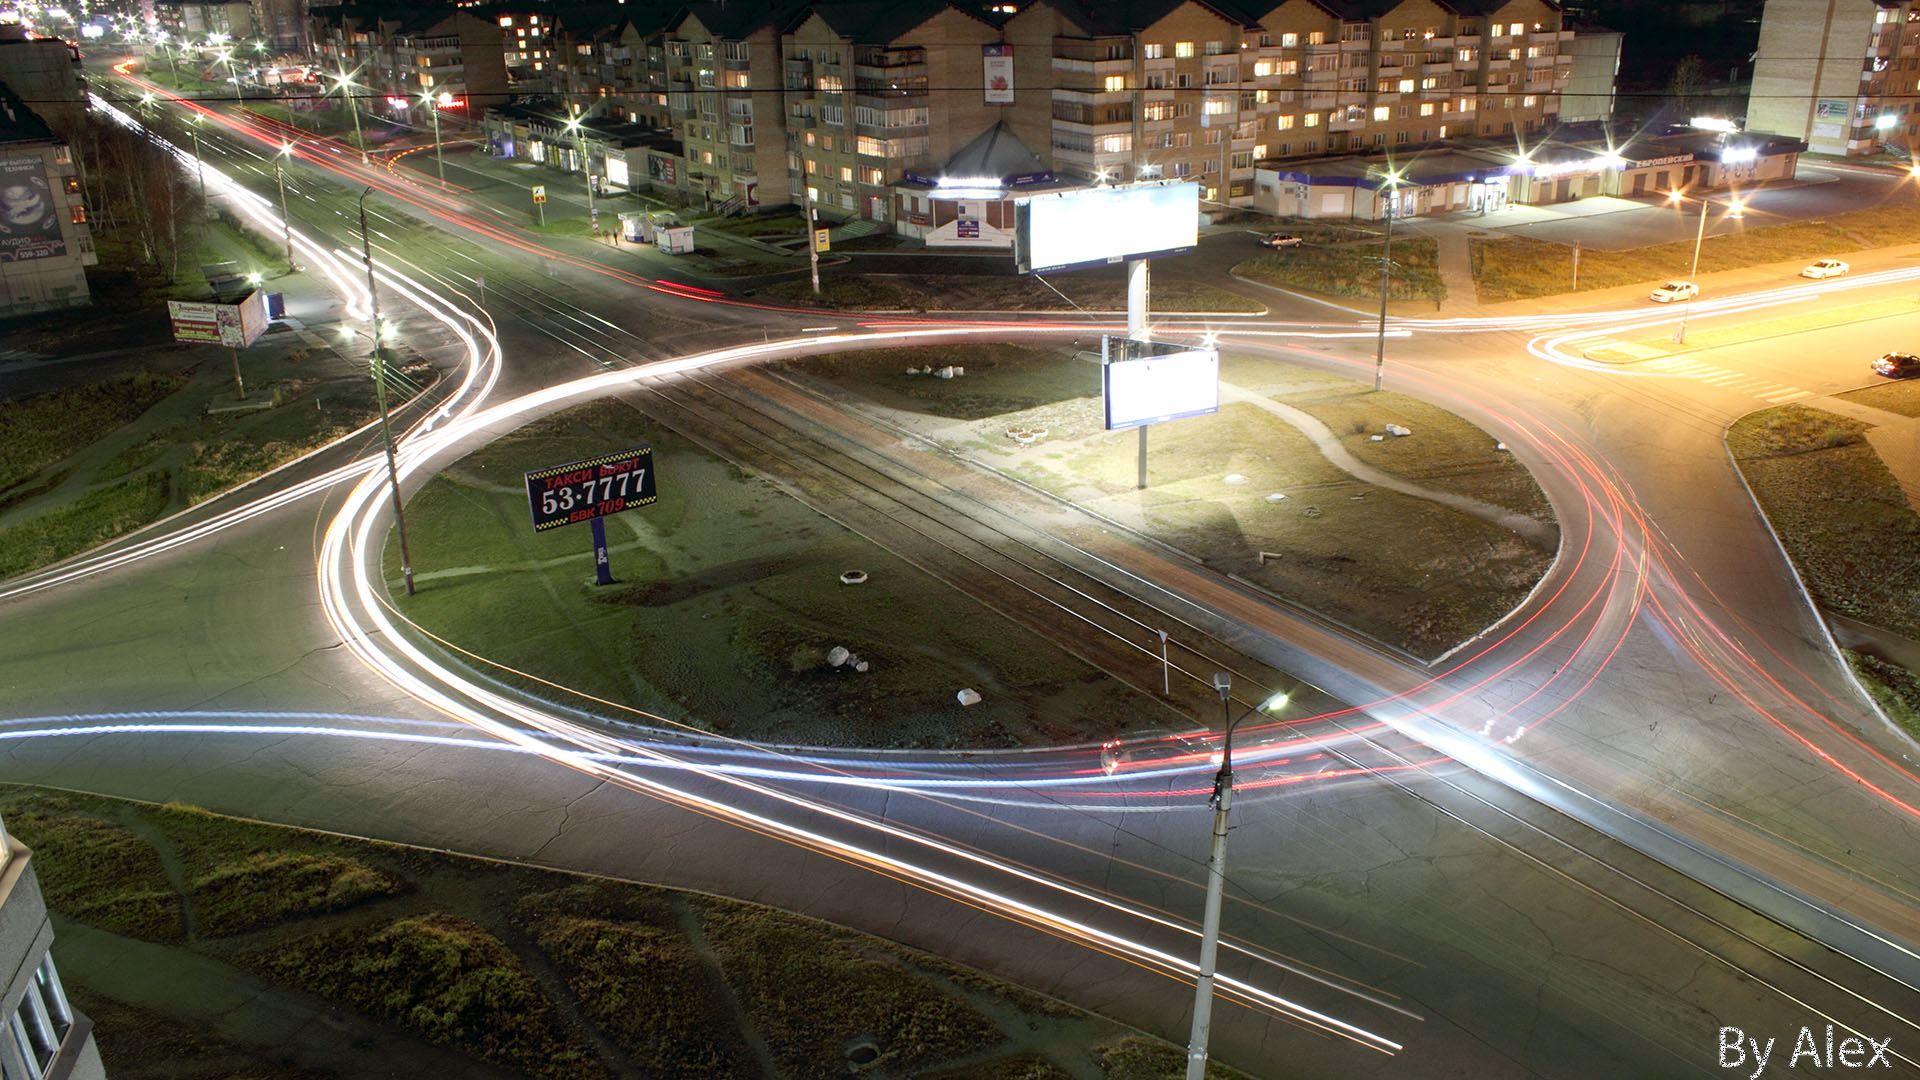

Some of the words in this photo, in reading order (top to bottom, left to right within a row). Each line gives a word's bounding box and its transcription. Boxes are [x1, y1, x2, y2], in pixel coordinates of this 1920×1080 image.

[1636, 152, 1695, 168] ЕВРОПЕЙСКИЙ
[545, 466, 592, 489] ТАКСИ
[570, 508, 596, 523] БВК
[597, 497, 625, 516] 709
